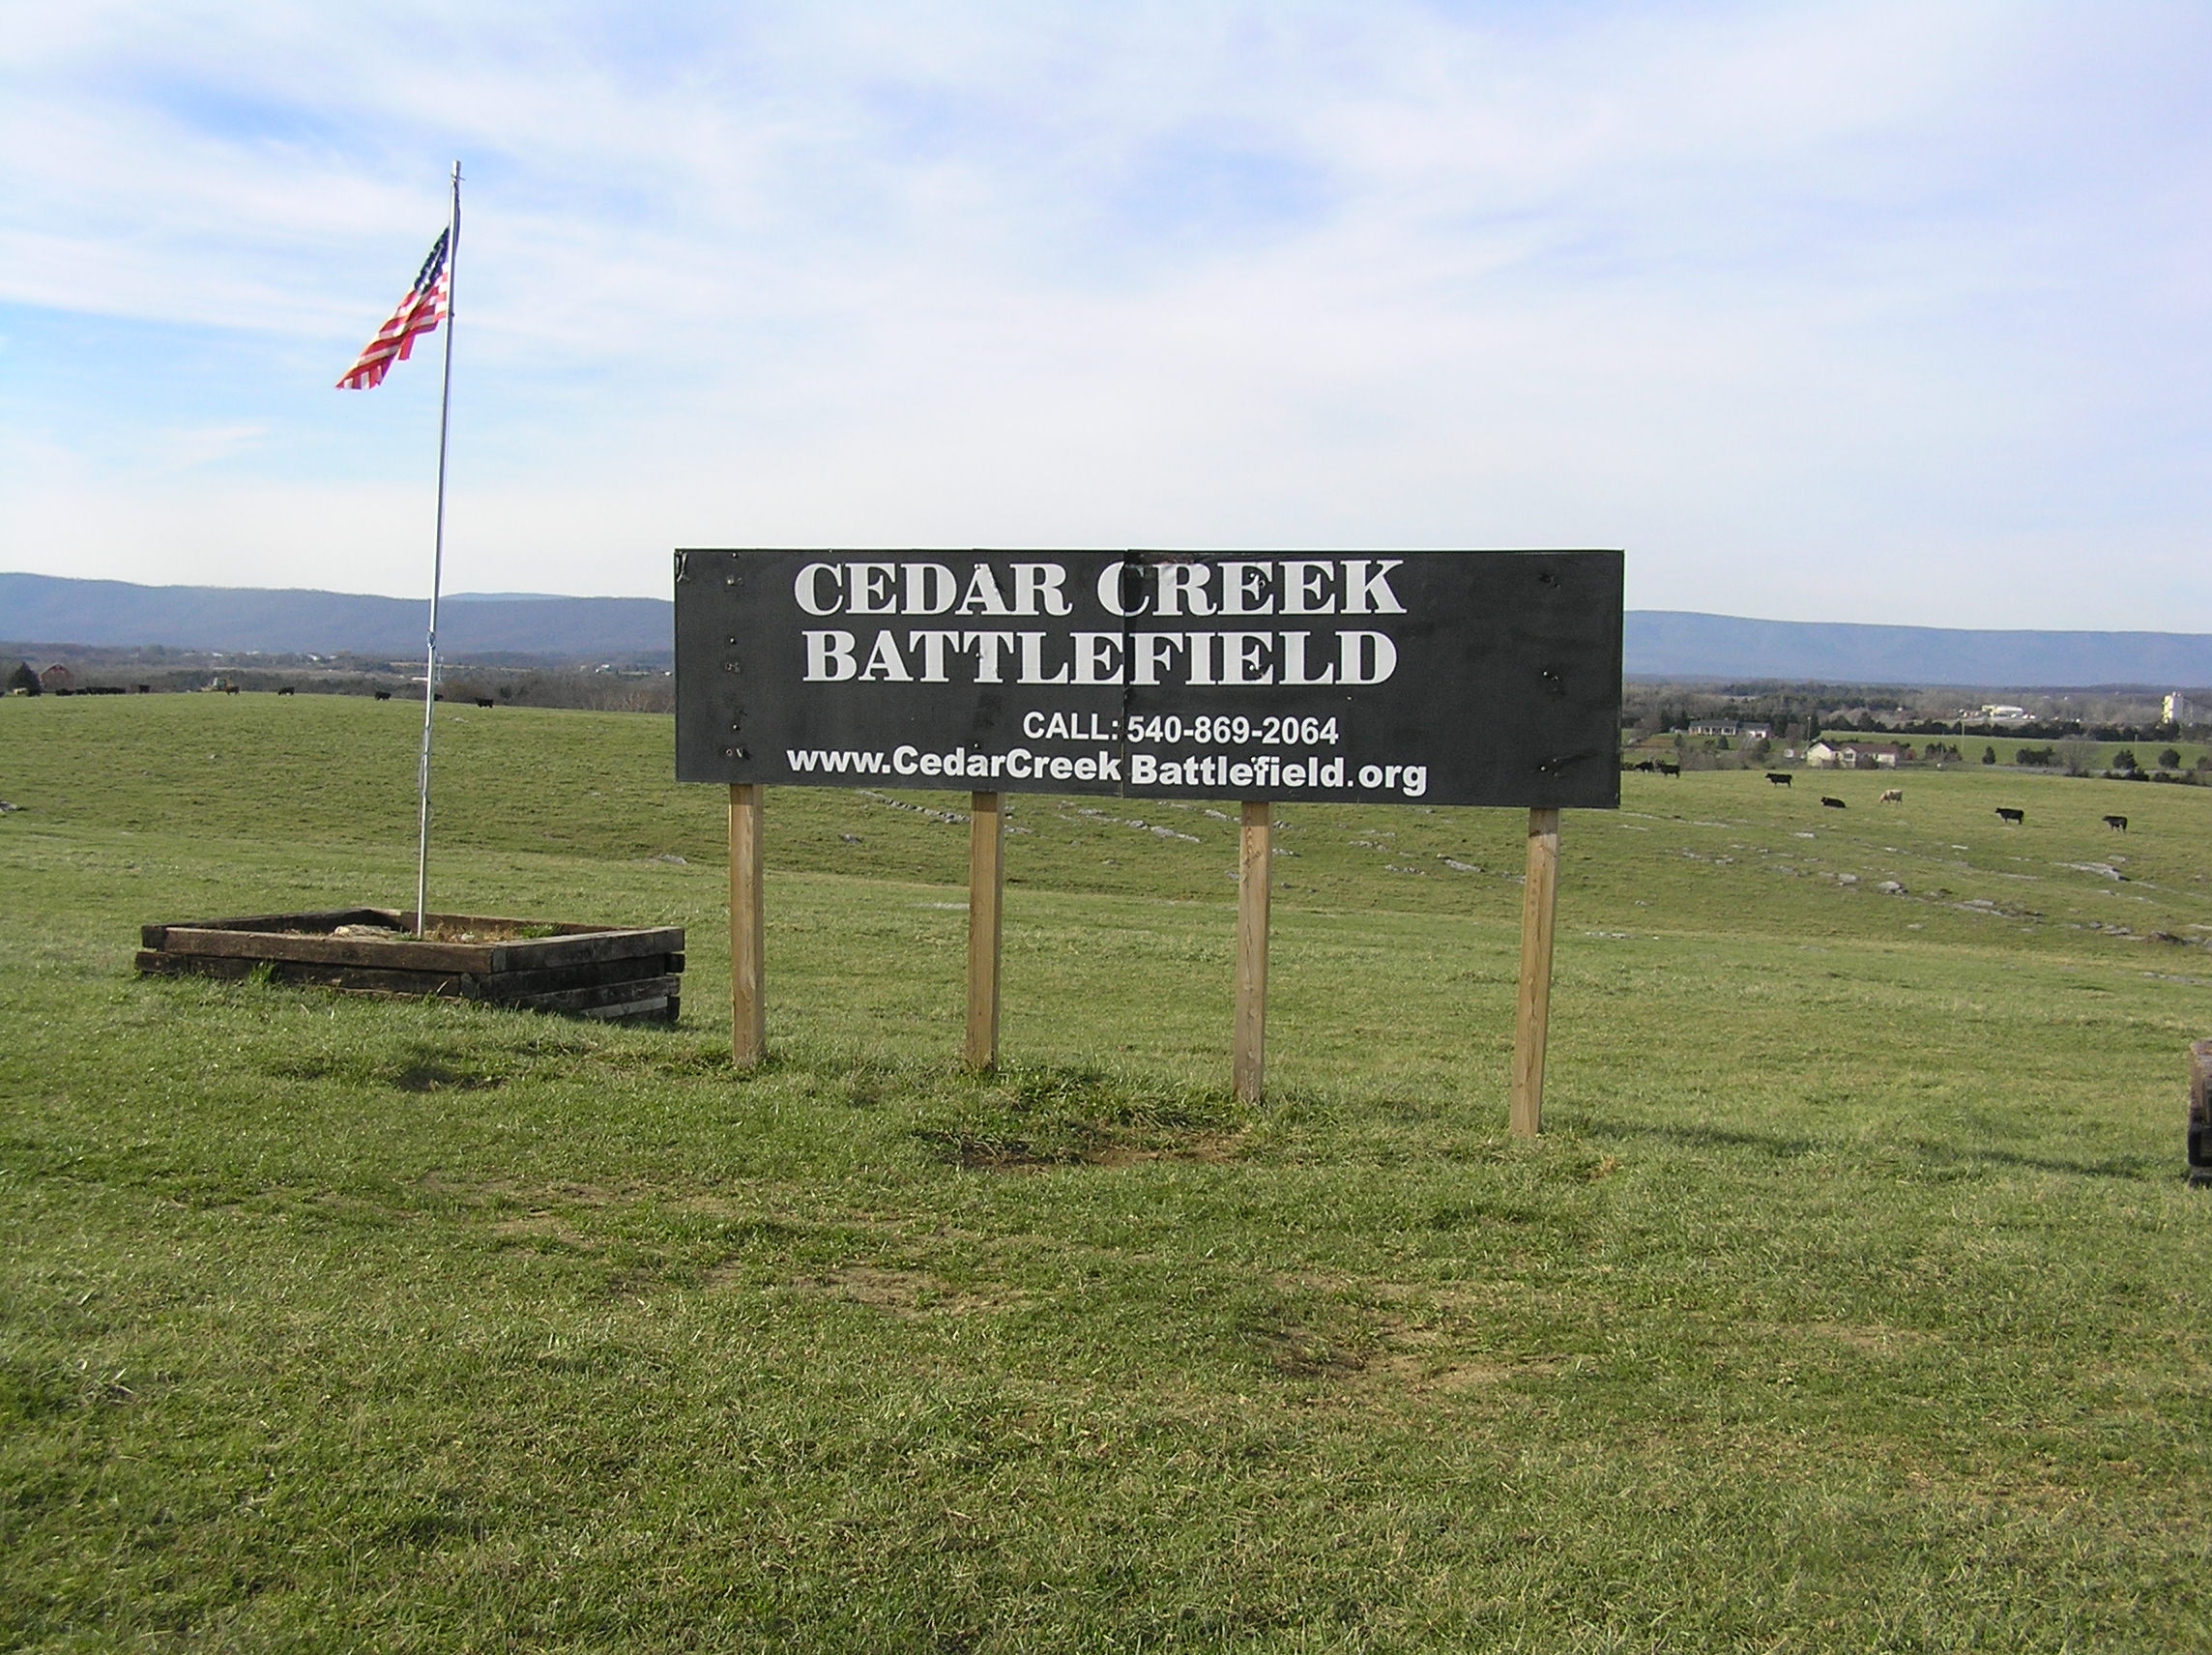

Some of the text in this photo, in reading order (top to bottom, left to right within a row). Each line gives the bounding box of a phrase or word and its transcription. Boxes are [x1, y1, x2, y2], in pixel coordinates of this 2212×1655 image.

[794, 559, 1408, 617] CEDAR CREEK
[801, 629, 1398, 685] BATTLEFIELD
[1023, 711, 1339, 745] CALL: 540-869-2064
